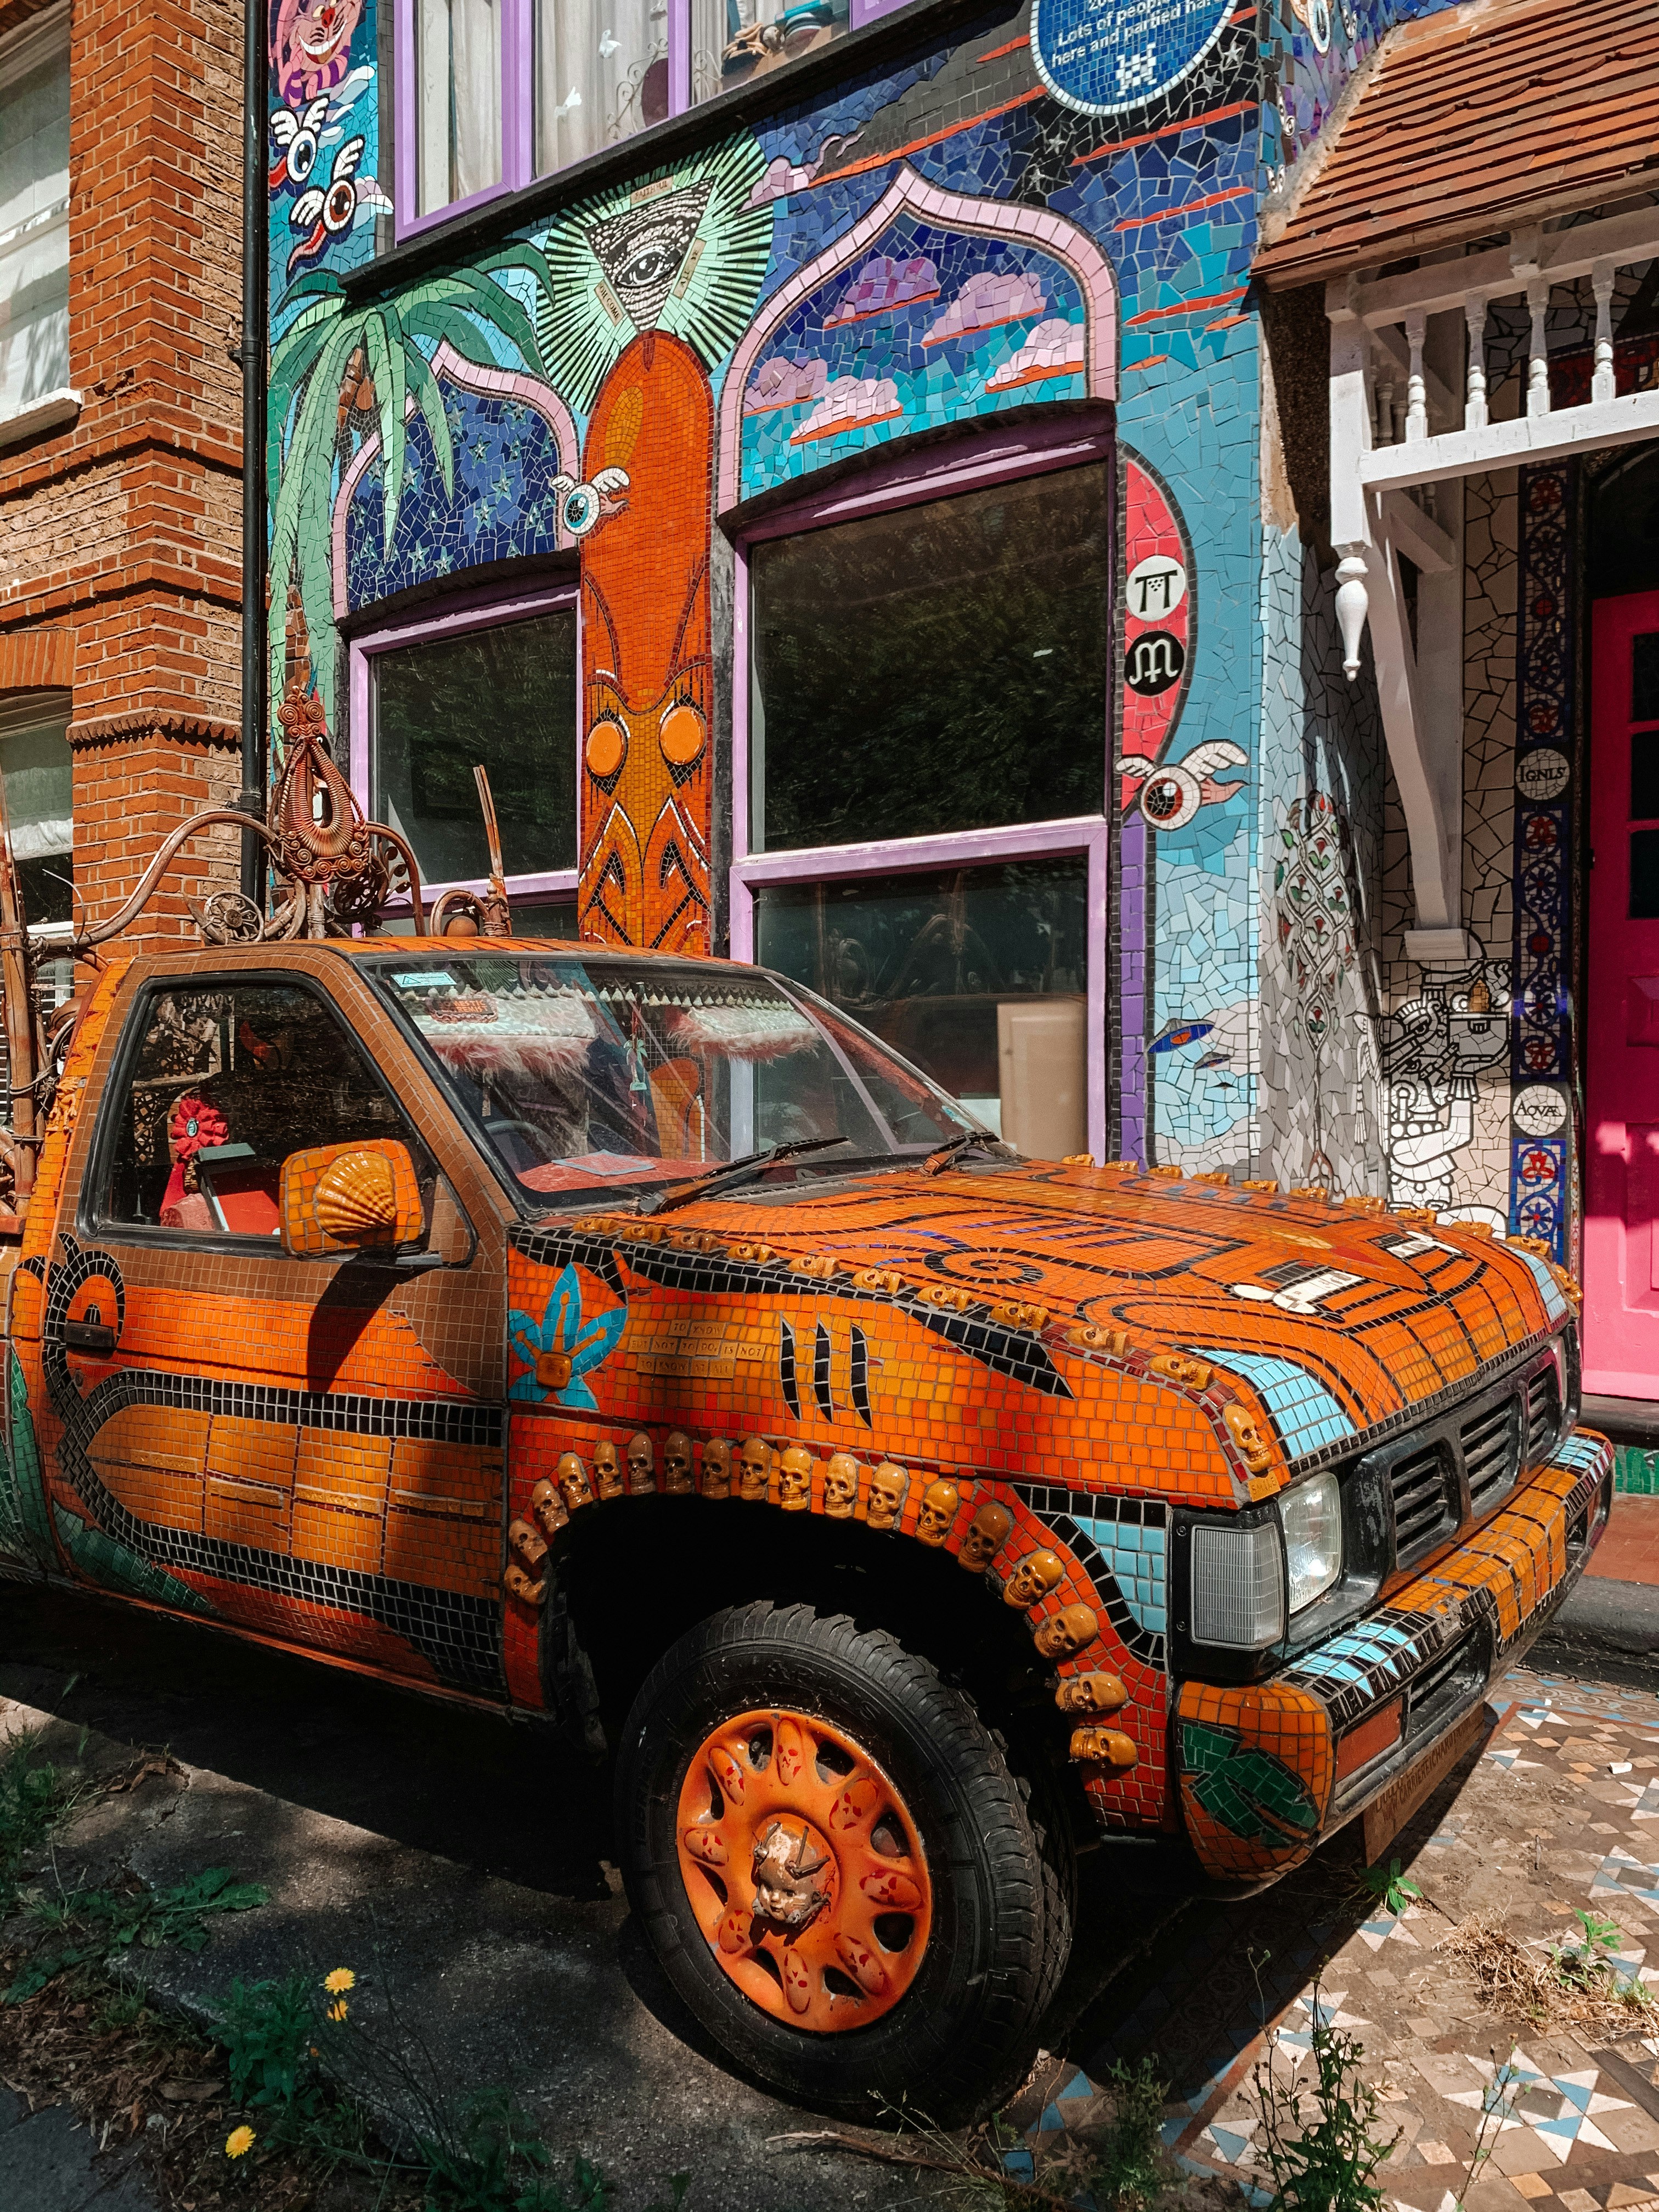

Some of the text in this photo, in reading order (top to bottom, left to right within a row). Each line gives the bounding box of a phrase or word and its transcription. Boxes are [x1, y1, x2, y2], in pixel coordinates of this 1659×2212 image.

[1052, 46, 1086, 68] here
[1090, 27, 1120, 52] and
[1125, 3, 1180, 39] partied
[1186, 0, 1224, 14] ha
[1058, 24, 1092, 46] Lots
[1097, 10, 1114, 30] of
[1117, 0, 1170, 26] peop
[673, 1322, 723, 1335] TO KNOW
[654, 1340, 675, 1350] NOT
[724, 1345, 734, 1355] IS
[740, 1346, 761, 1357] NOT
